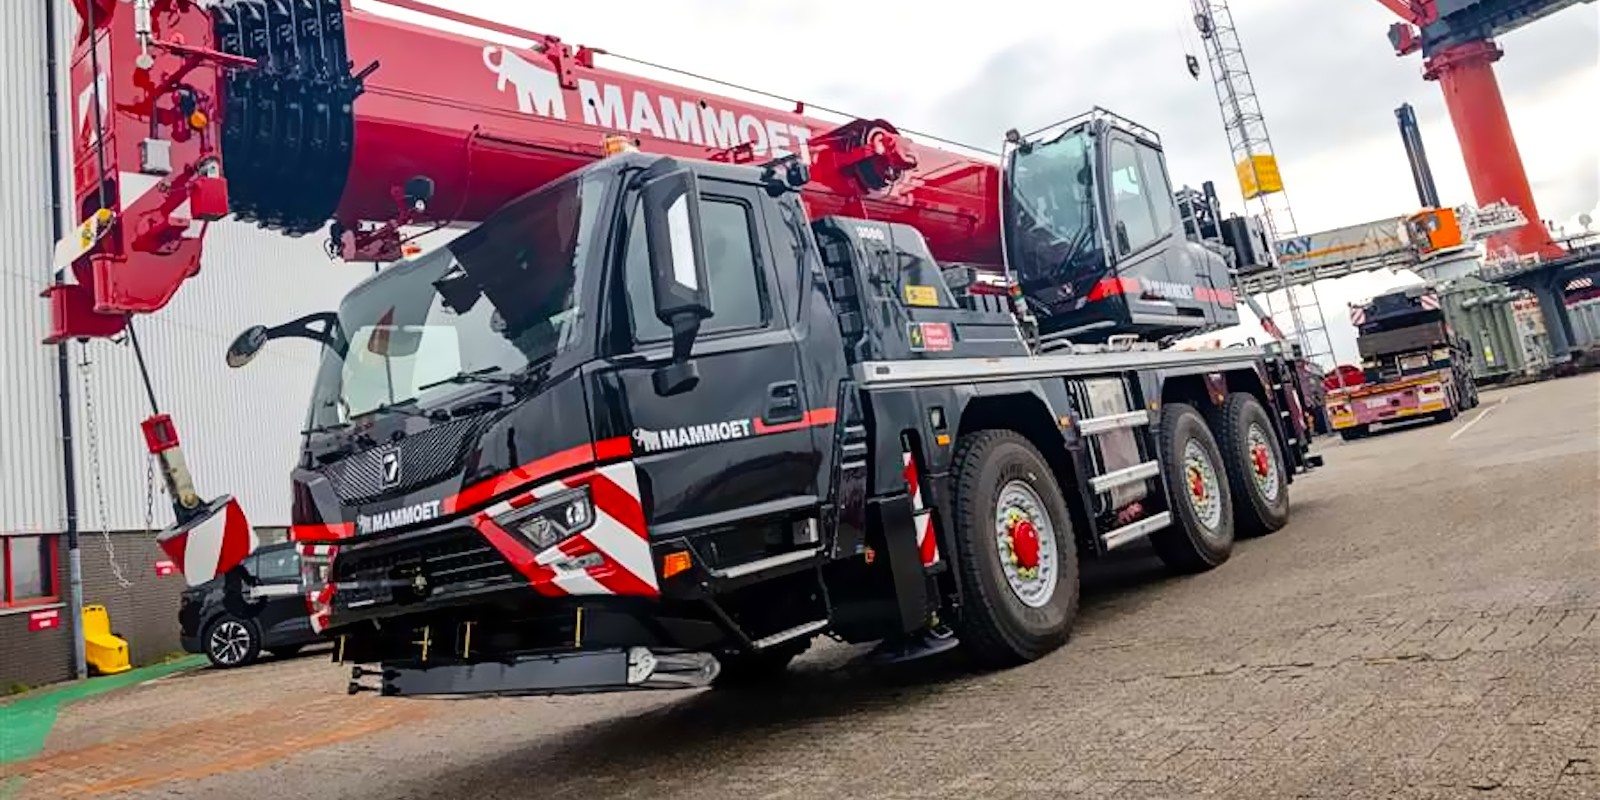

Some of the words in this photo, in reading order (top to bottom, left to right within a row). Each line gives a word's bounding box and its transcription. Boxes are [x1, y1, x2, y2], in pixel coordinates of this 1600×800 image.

[578, 78, 812, 166] MAMMOET
[660, 418, 750, 449] MAMMOET
[372, 499, 440, 533] MAMMOET
